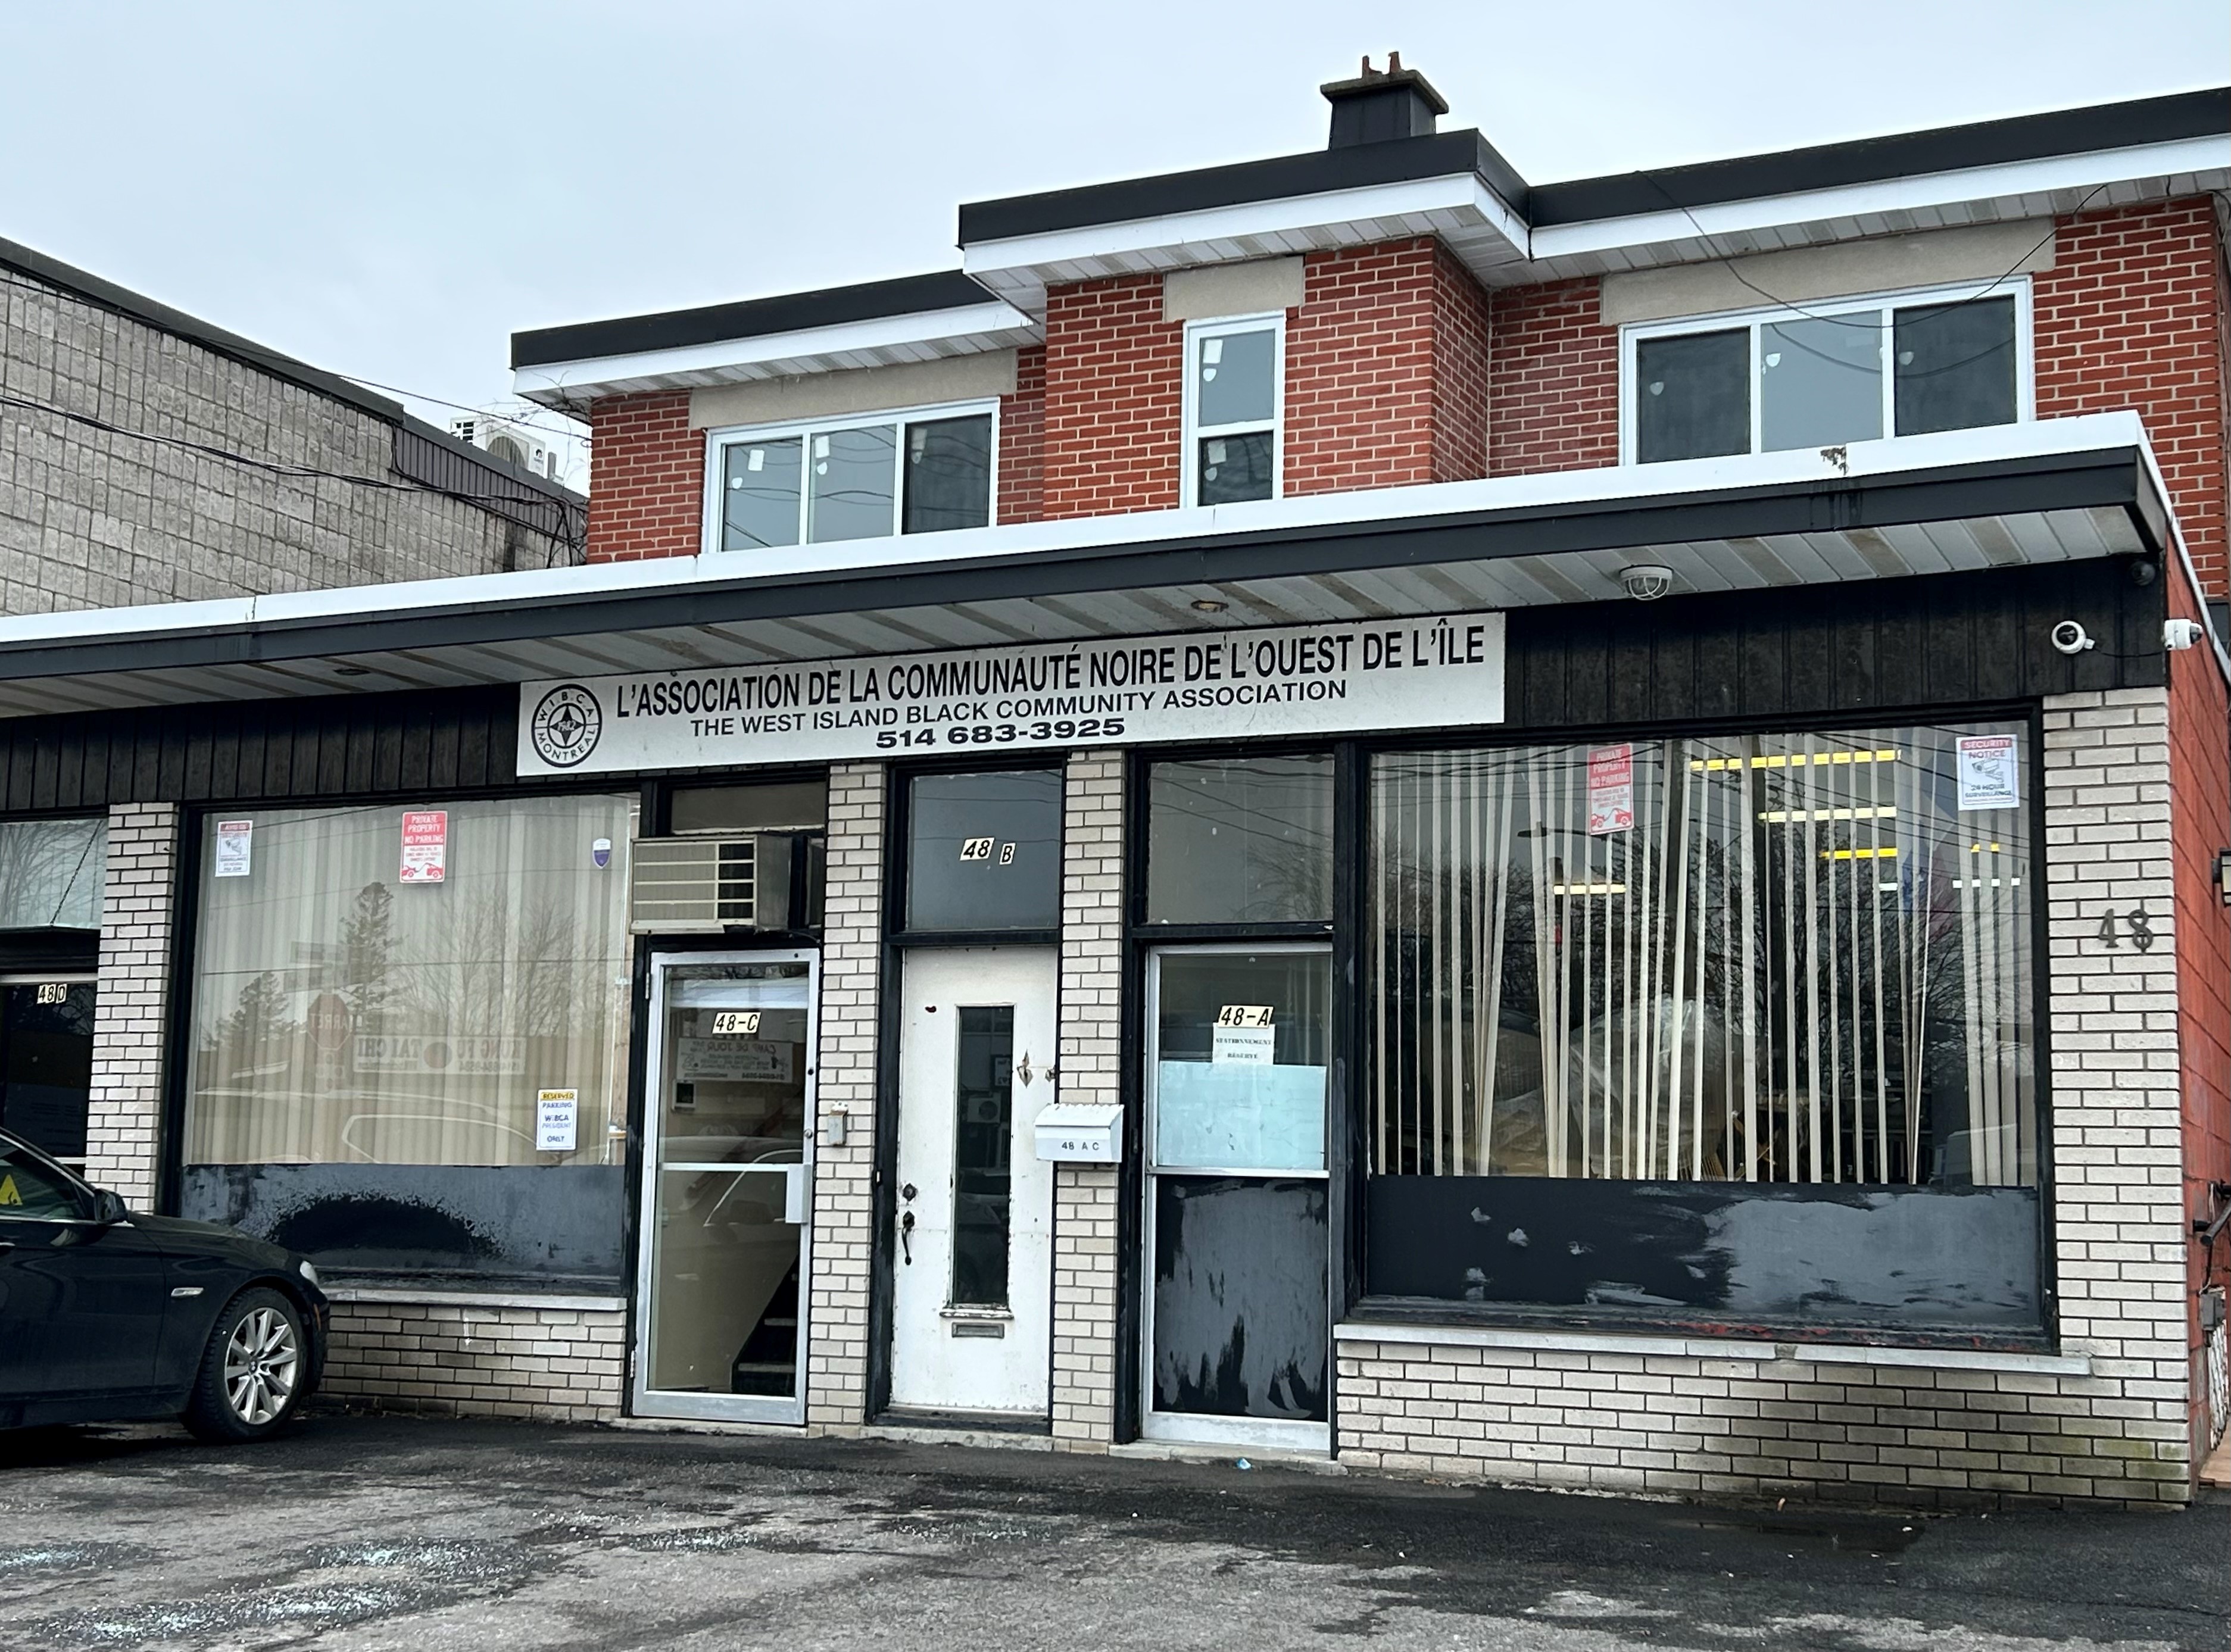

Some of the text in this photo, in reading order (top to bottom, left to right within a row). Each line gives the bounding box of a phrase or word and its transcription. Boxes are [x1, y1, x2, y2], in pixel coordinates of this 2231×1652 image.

[617, 617, 1484, 718] L'ASSOCIATION DE LA COMMUNAUTÉ NOIRE DE L'OUEST DE L'ÎLE
[690, 680, 1346, 736] THE WEST ISLAND BLACK COMMUNITY ASSOCIATION
[876, 717, 1125, 748] 514 683-3925
[537, 729, 595, 761] MONTREAL
[1964, 739, 2010, 748] SECURITY
[1968, 750, 2006, 758] NOTICE
[1590, 776, 1600, 787] NO
[407, 824, 440, 833] PROPERTY
[404, 835, 444, 844] NO PARKING
[963, 840, 1012, 863] 48 B
[2098, 908, 2154, 954] 48
[716, 1014, 758, 1032] 48-C
[1221, 1007, 1270, 1026] 48-A
[1062, 1141, 1100, 1151] 48 A C
